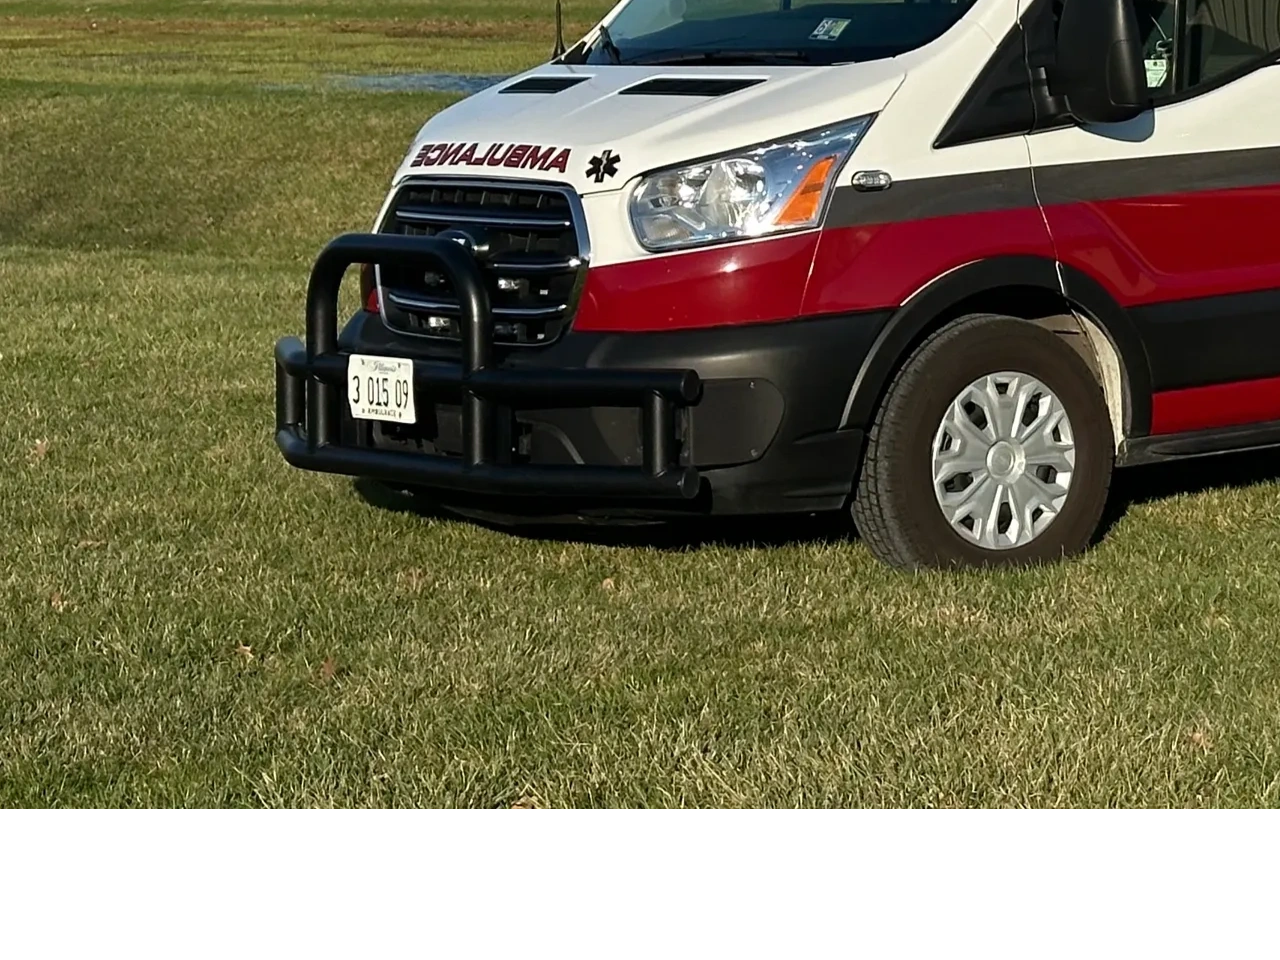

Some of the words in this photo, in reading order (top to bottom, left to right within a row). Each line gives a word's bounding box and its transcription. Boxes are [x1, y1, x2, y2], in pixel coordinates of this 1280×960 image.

[352, 375, 360, 404] 3
[367, 376, 389, 407] 015
[395, 379, 409, 409] 09
